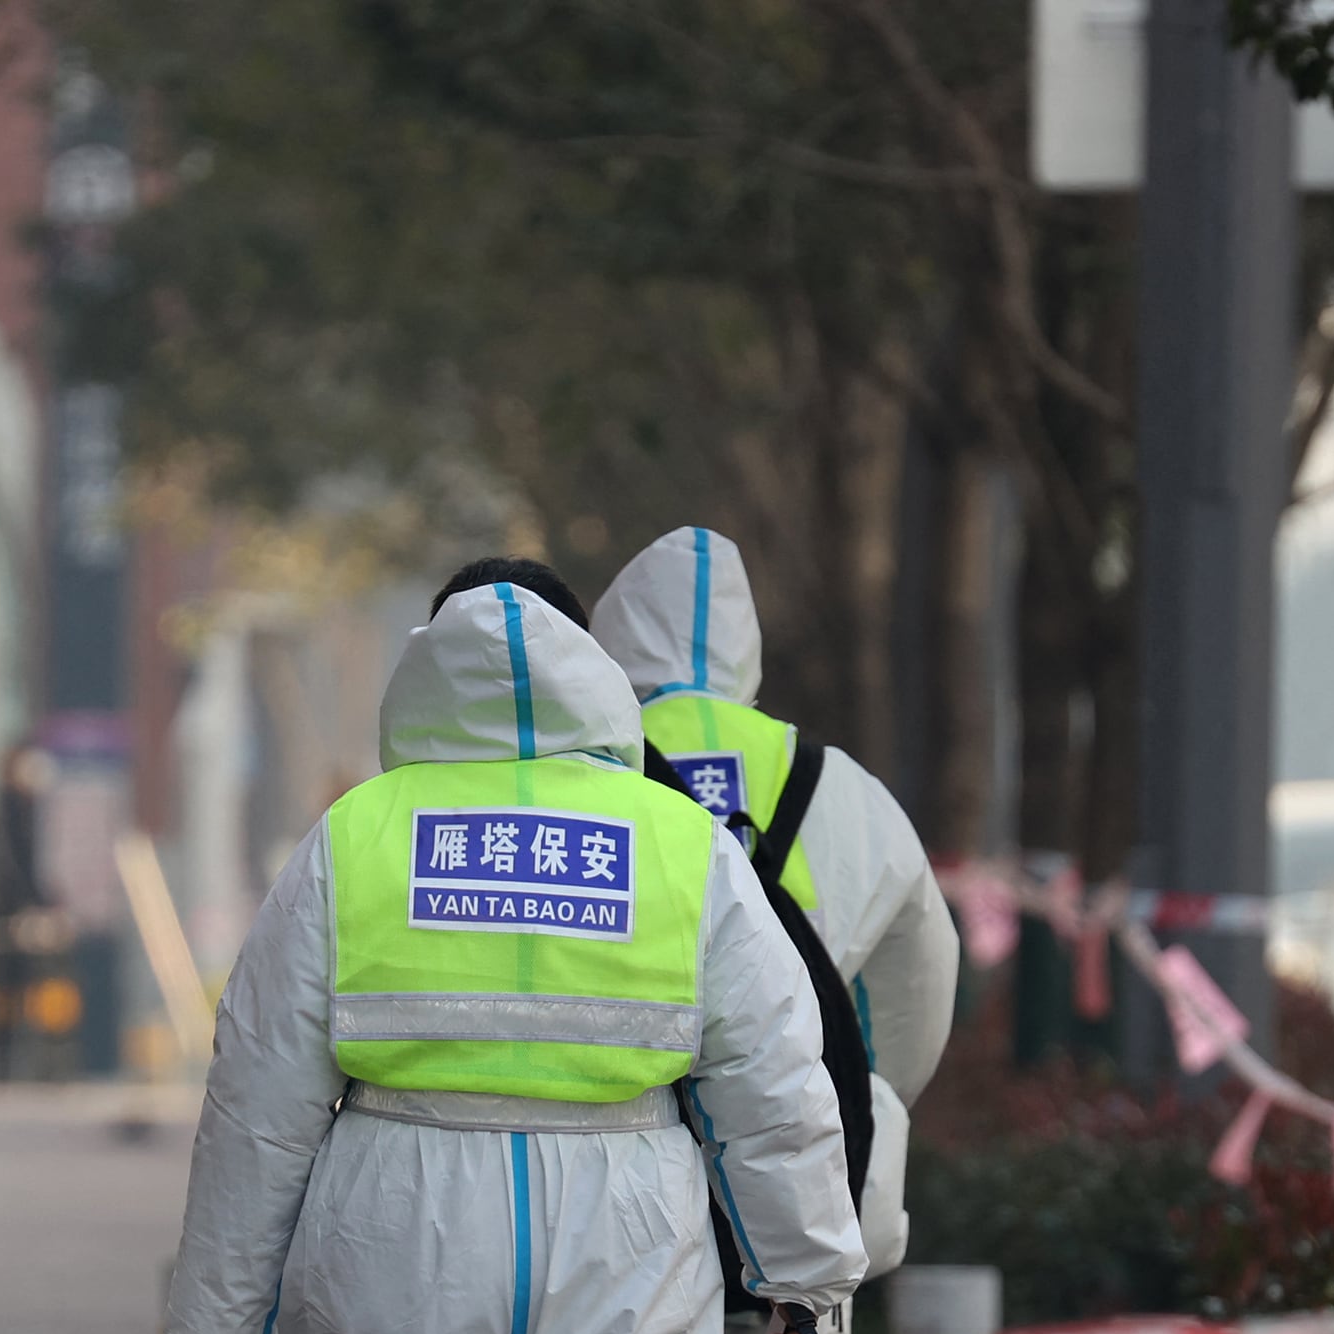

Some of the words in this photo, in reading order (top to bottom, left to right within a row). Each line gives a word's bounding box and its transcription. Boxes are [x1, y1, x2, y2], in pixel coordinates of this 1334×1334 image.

[429, 822, 617, 882] 雁塔保安
[427, 894, 478, 916] YAN
[485, 897, 516, 917] TA
[524, 899, 574, 921] BAO
[581, 904, 616, 926] AN
